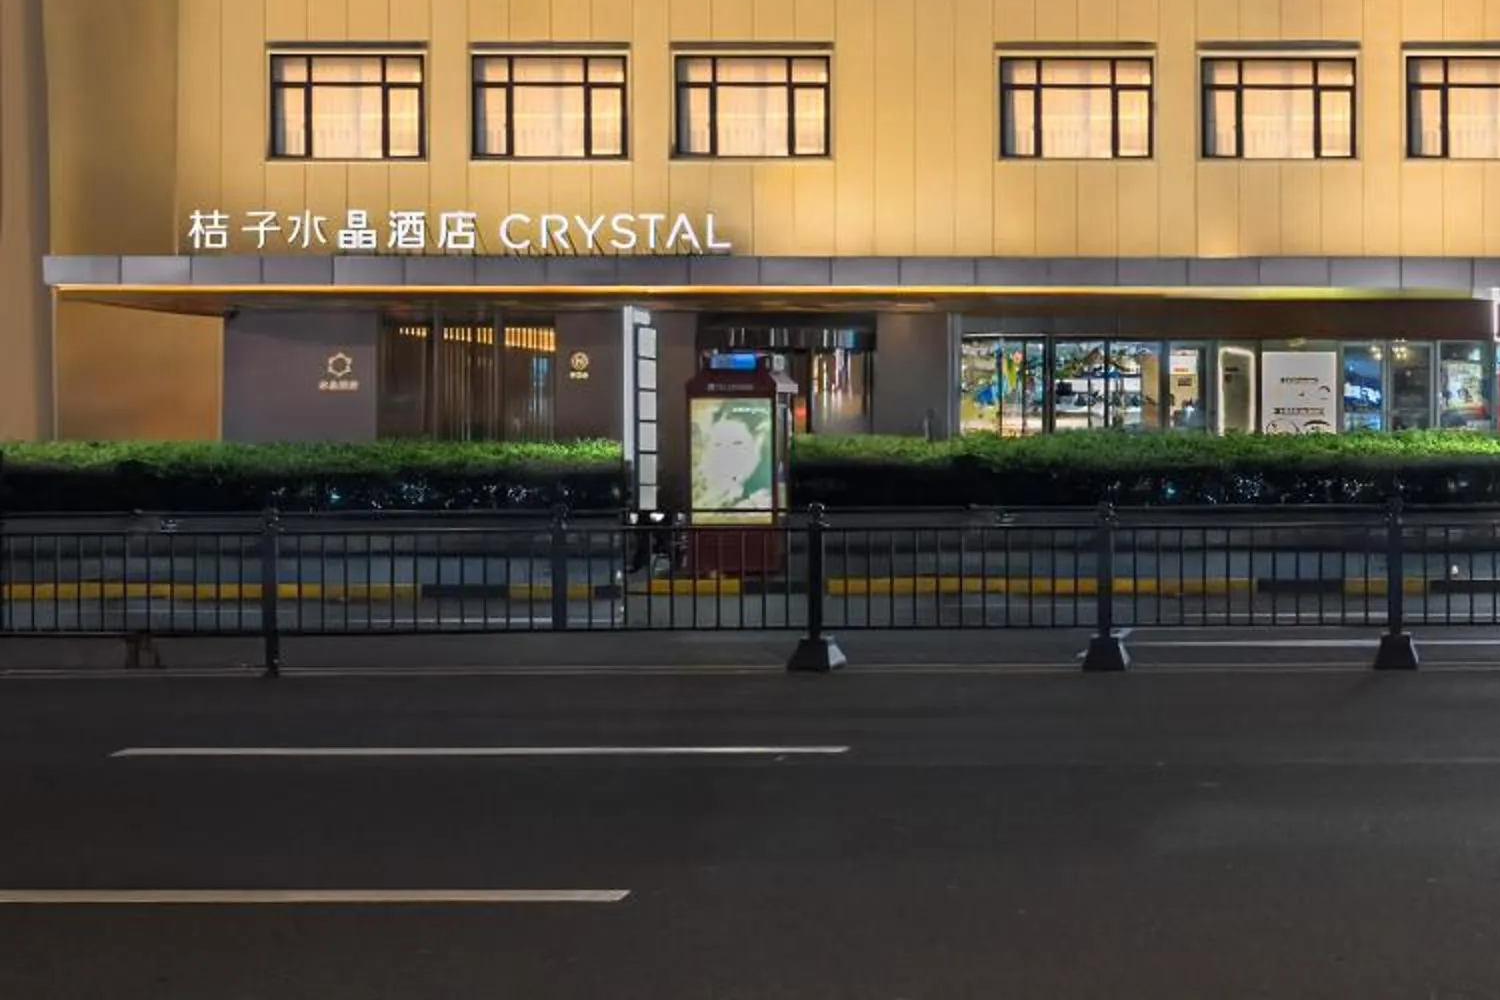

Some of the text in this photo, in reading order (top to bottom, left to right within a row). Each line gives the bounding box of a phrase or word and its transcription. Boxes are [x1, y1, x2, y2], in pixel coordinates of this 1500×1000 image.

[188, 209, 732, 251] 桔子水晶酒店 CRYSTAL
